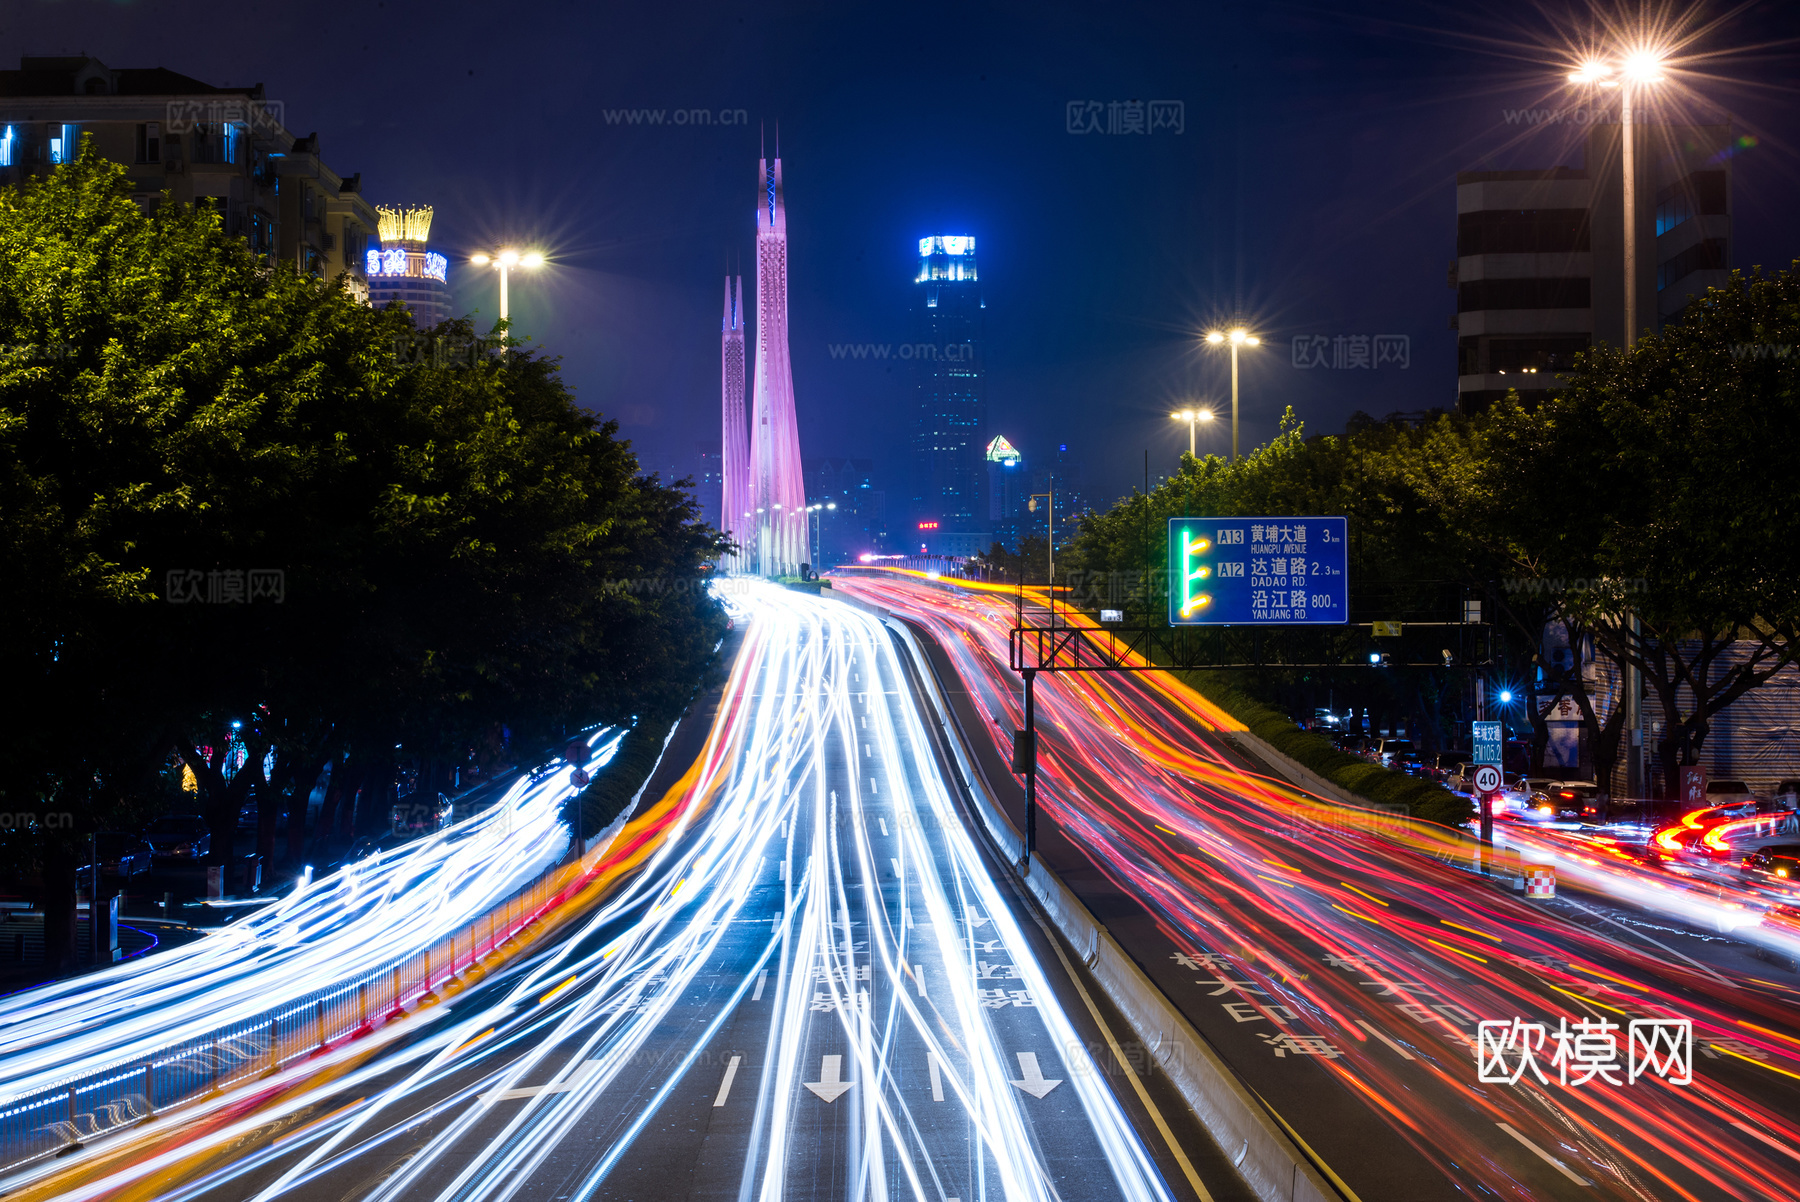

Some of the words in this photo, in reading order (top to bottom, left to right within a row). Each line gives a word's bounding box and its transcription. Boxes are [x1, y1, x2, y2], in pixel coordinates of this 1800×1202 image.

[1219, 530, 1242, 544] A13
[1251, 525, 1307, 543] 黄埔大道
[1251, 544, 1281, 554] HUANGPU
[1283, 544, 1307, 554] AVENUE
[1219, 563, 1243, 577] A12
[1251, 558, 1307, 576] 达道路
[1251, 577, 1287, 587] DADAO
[1292, 577, 1308, 587] RD.
[1252, 590, 1308, 609] 沿江路
[1252, 609, 1291, 620] YANJIANG
[1294, 609, 1308, 620] RD.
[1474, 725, 1500, 742] 羊城交通
[1474, 744, 1501, 762] FM105.2
[1479, 772, 1497, 786] 40
